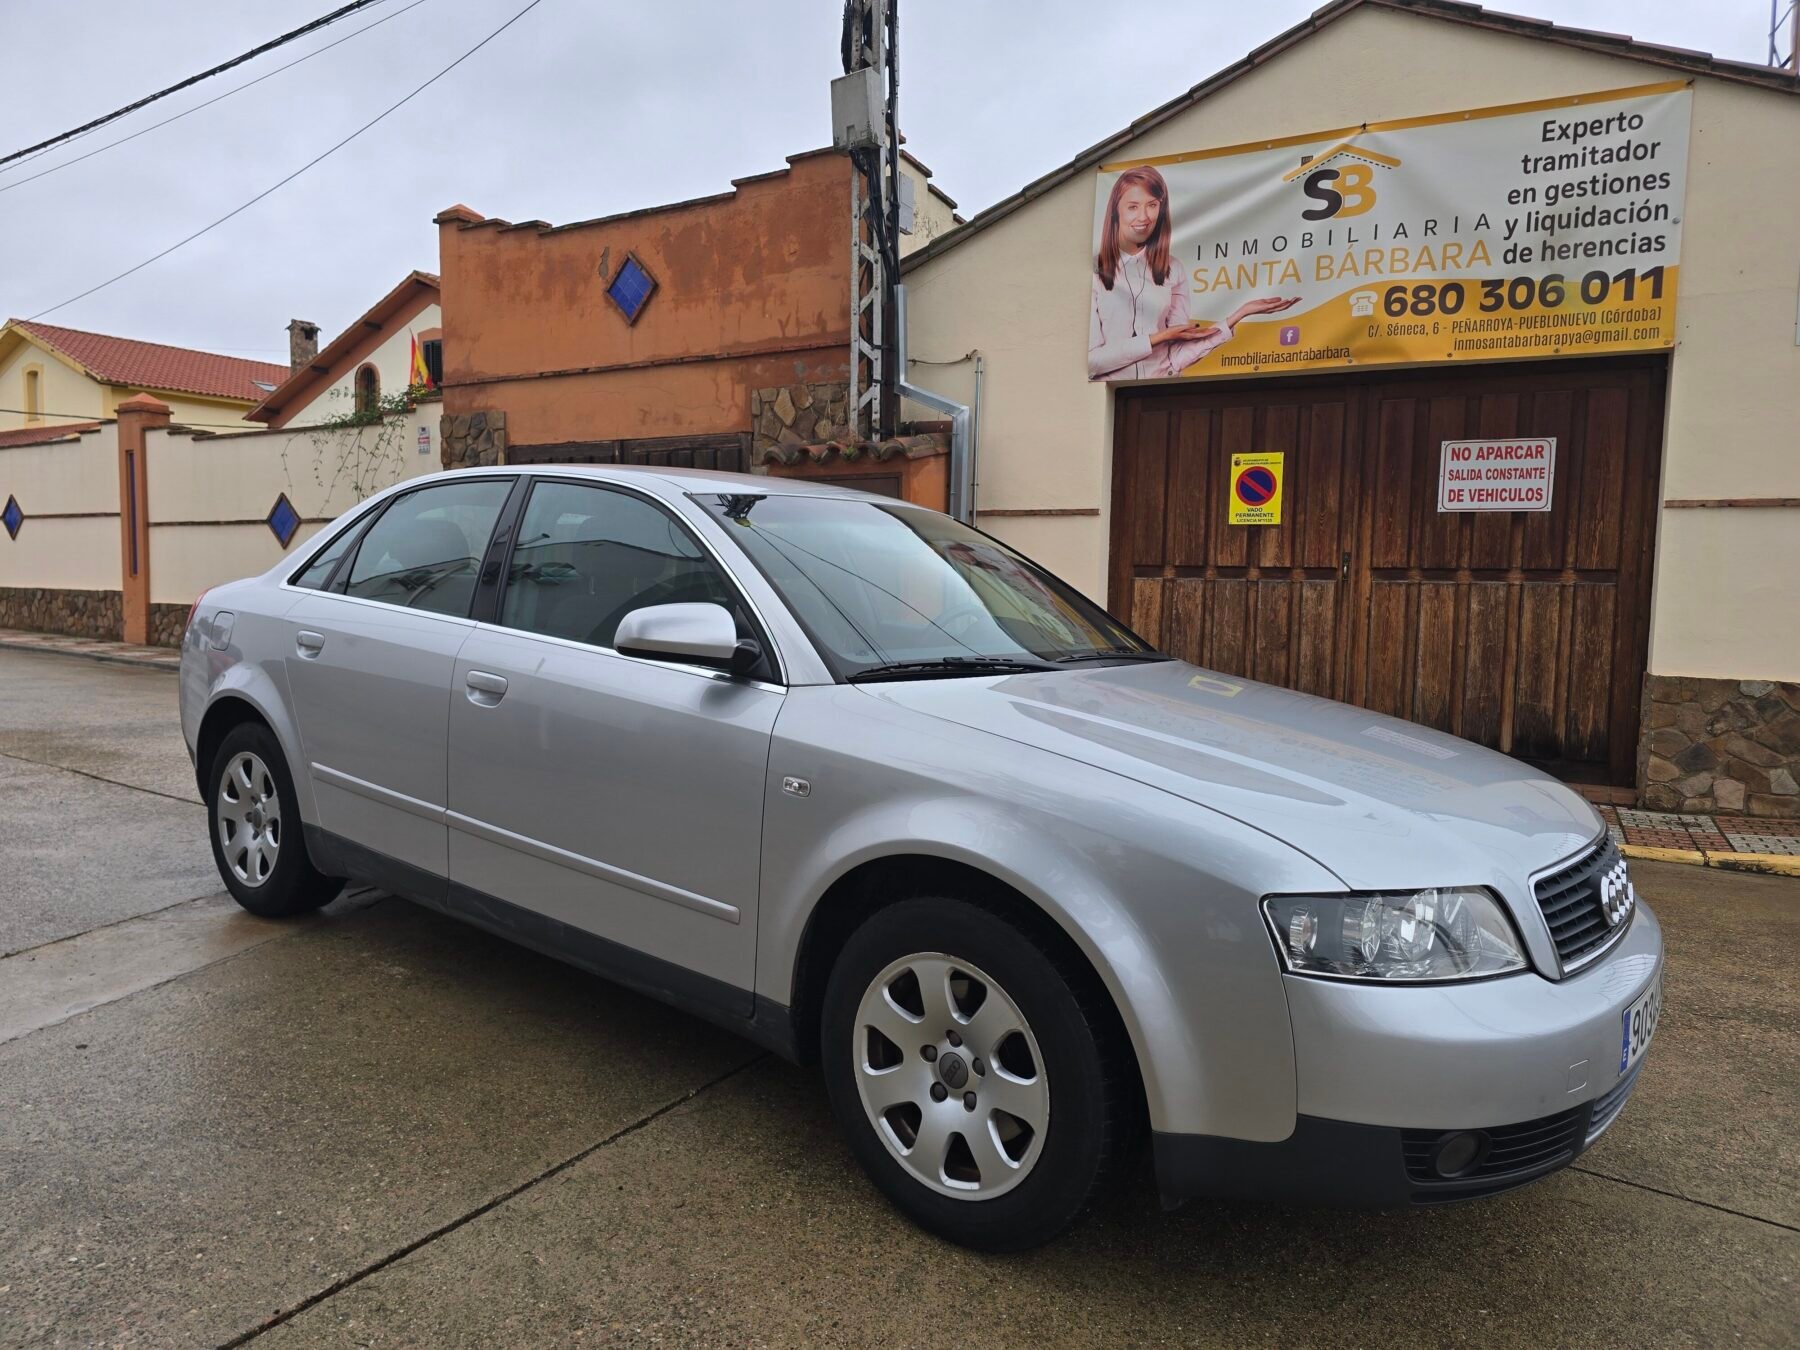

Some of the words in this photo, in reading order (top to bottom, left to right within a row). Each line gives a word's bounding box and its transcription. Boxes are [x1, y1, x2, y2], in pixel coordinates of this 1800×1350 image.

[1542, 113, 1644, 143] Experto
[1521, 140, 1661, 175] tramitador
[1301, 163, 1376, 221] SB
[1508, 183, 1536, 205] en
[1545, 171, 1670, 206] gestiones
[1504, 215, 1519, 240] y
[1526, 200, 1669, 233] liquidación
[1196, 213, 1491, 261] INMOBILIARIA
[1503, 242, 1533, 265] de
[1541, 233, 1666, 262] herencias
[1193, 258, 1301, 293] SANTA
[1315, 239, 1492, 281] BÁRBARA
[1384, 282, 1465, 317] 680
[1479, 274, 1564, 313] 306
[1580, 266, 1664, 306] 011
[1387, 321, 1429, 336] Séneca,
[1432, 322, 1440, 334] 6
[1452, 312, 1596, 334] PEÑARROYA-PUEBLONUEVO
[1601, 306, 1661, 325] (Córdoba)
[1454, 326, 1660, 352] inmosantabarbarapya@gmail.com
[1221, 346, 1350, 367] inmobiliariasantabarbara
[1451, 447, 1471, 461] NO
[1476, 445, 1544, 460] APARCAR
[1448, 469, 1482, 481] SALIDA
[1486, 468, 1545, 480] CONSTANTE
[1448, 489, 1464, 502] DE
[1469, 488, 1543, 502] VEHICULOS
